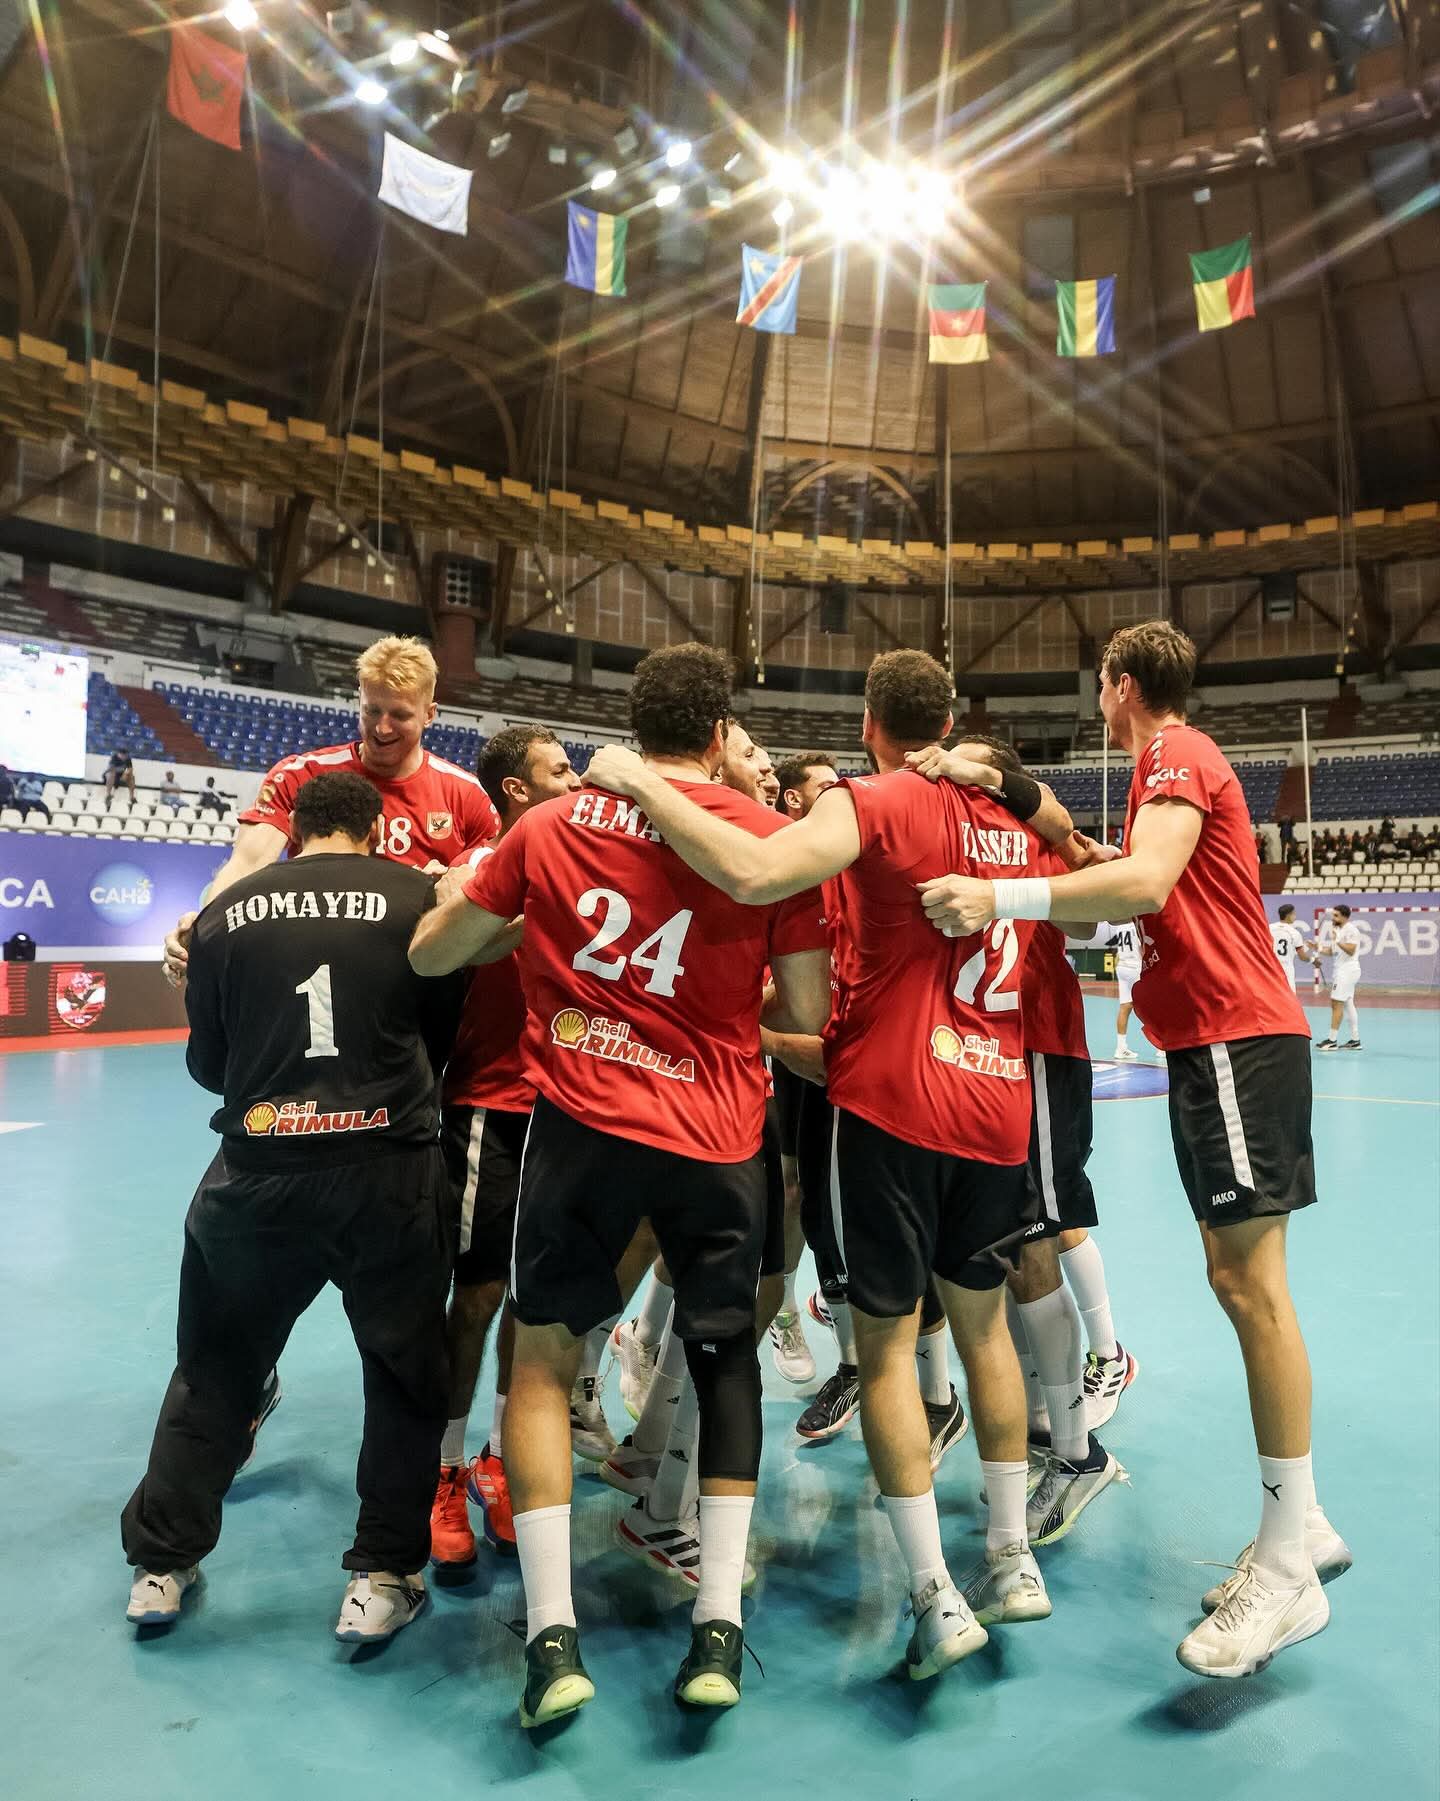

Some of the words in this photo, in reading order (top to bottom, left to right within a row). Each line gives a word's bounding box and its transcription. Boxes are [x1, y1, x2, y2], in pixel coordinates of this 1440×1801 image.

[568, 794, 666, 844] ELMA
[225, 891, 388, 933] HOMAYED
[573, 888, 693, 997] 24
[295, 964, 339, 1058] 1
[591, 1018, 629, 1037] Shell
[584, 1034, 695, 1081] RIMULA
[966, 1037, 997, 1054] Shell
[962, 1052, 1026, 1079] RIMU
[277, 1109, 389, 1135] RIMULA
[280, 1101, 316, 1115] Shell
